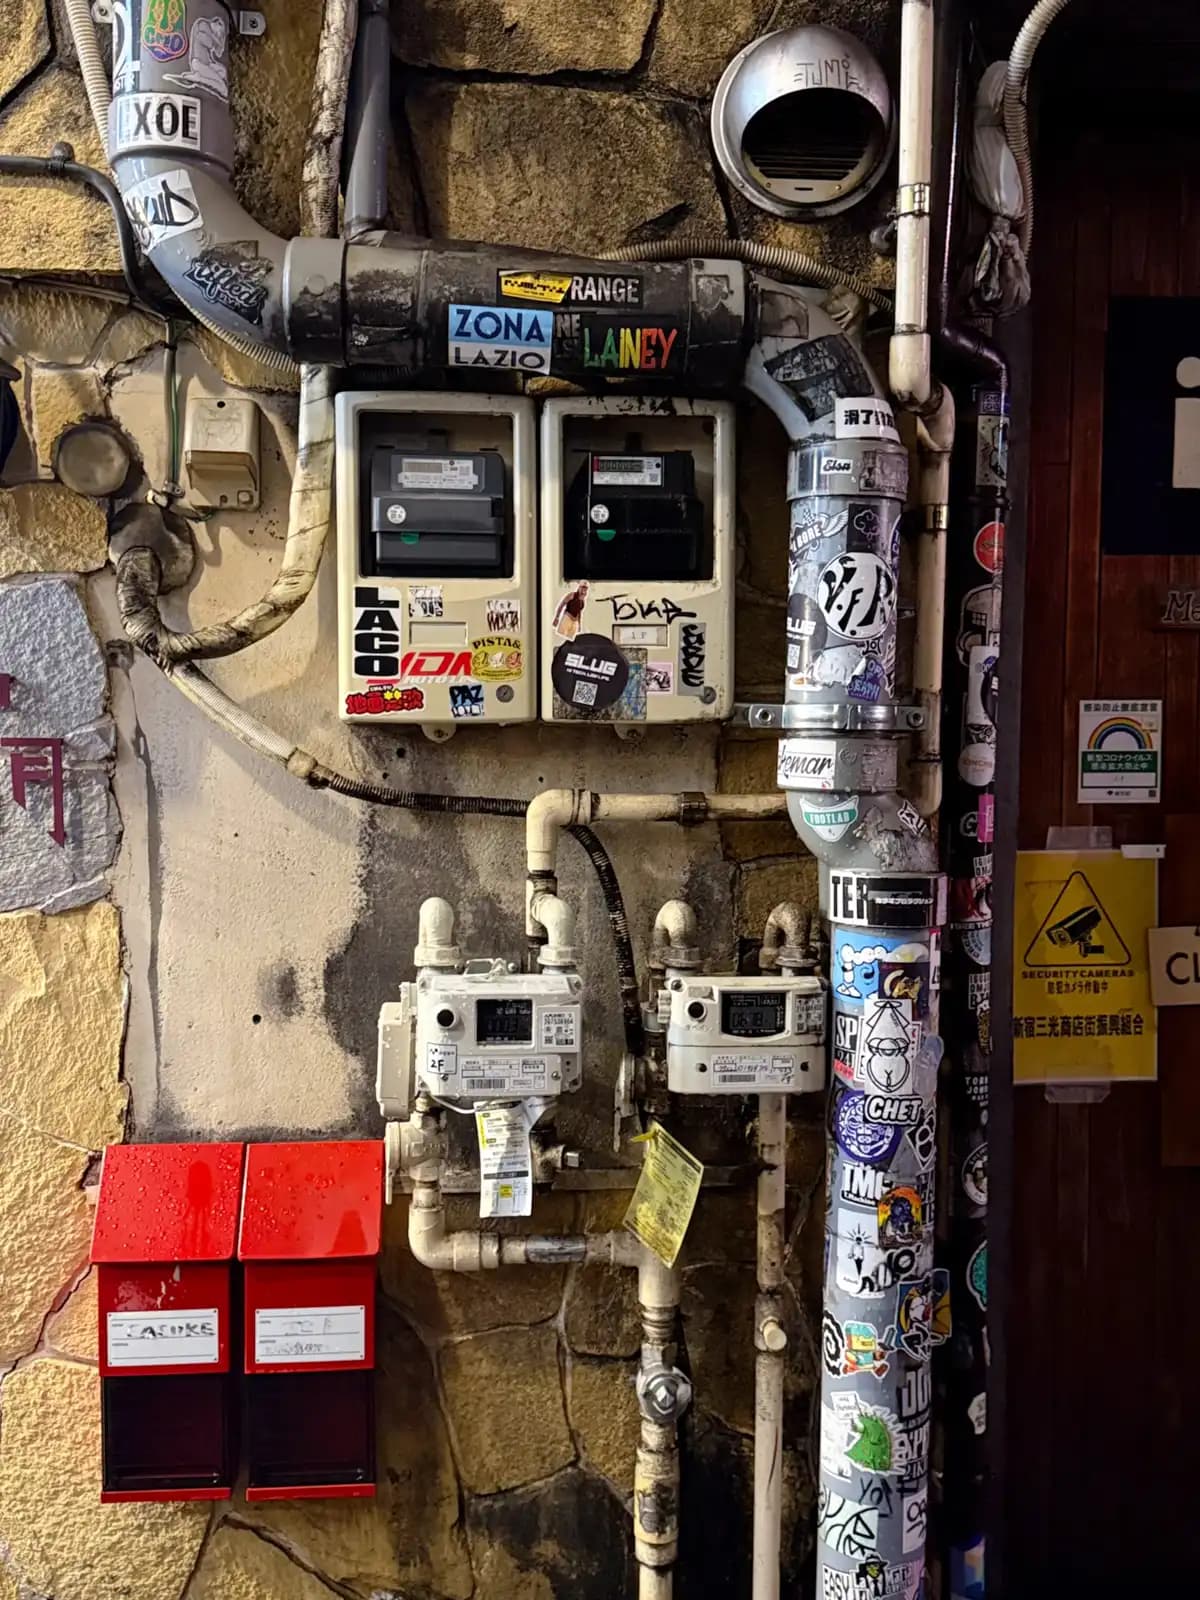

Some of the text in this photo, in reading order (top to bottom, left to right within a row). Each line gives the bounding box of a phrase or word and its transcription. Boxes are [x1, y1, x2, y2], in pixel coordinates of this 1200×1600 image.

[571, 276, 640, 304] RANGE
[455, 309, 545, 342] ZONA
[455, 347, 545, 370] LAZIO
[584, 327, 677, 369] LAINEY
[354, 586, 400, 677] LACO
[565, 653, 618, 676] SLUG
[1022, 969, 1134, 979] SECURITY CAMERAS
[869, 1096, 922, 1122] CHET
